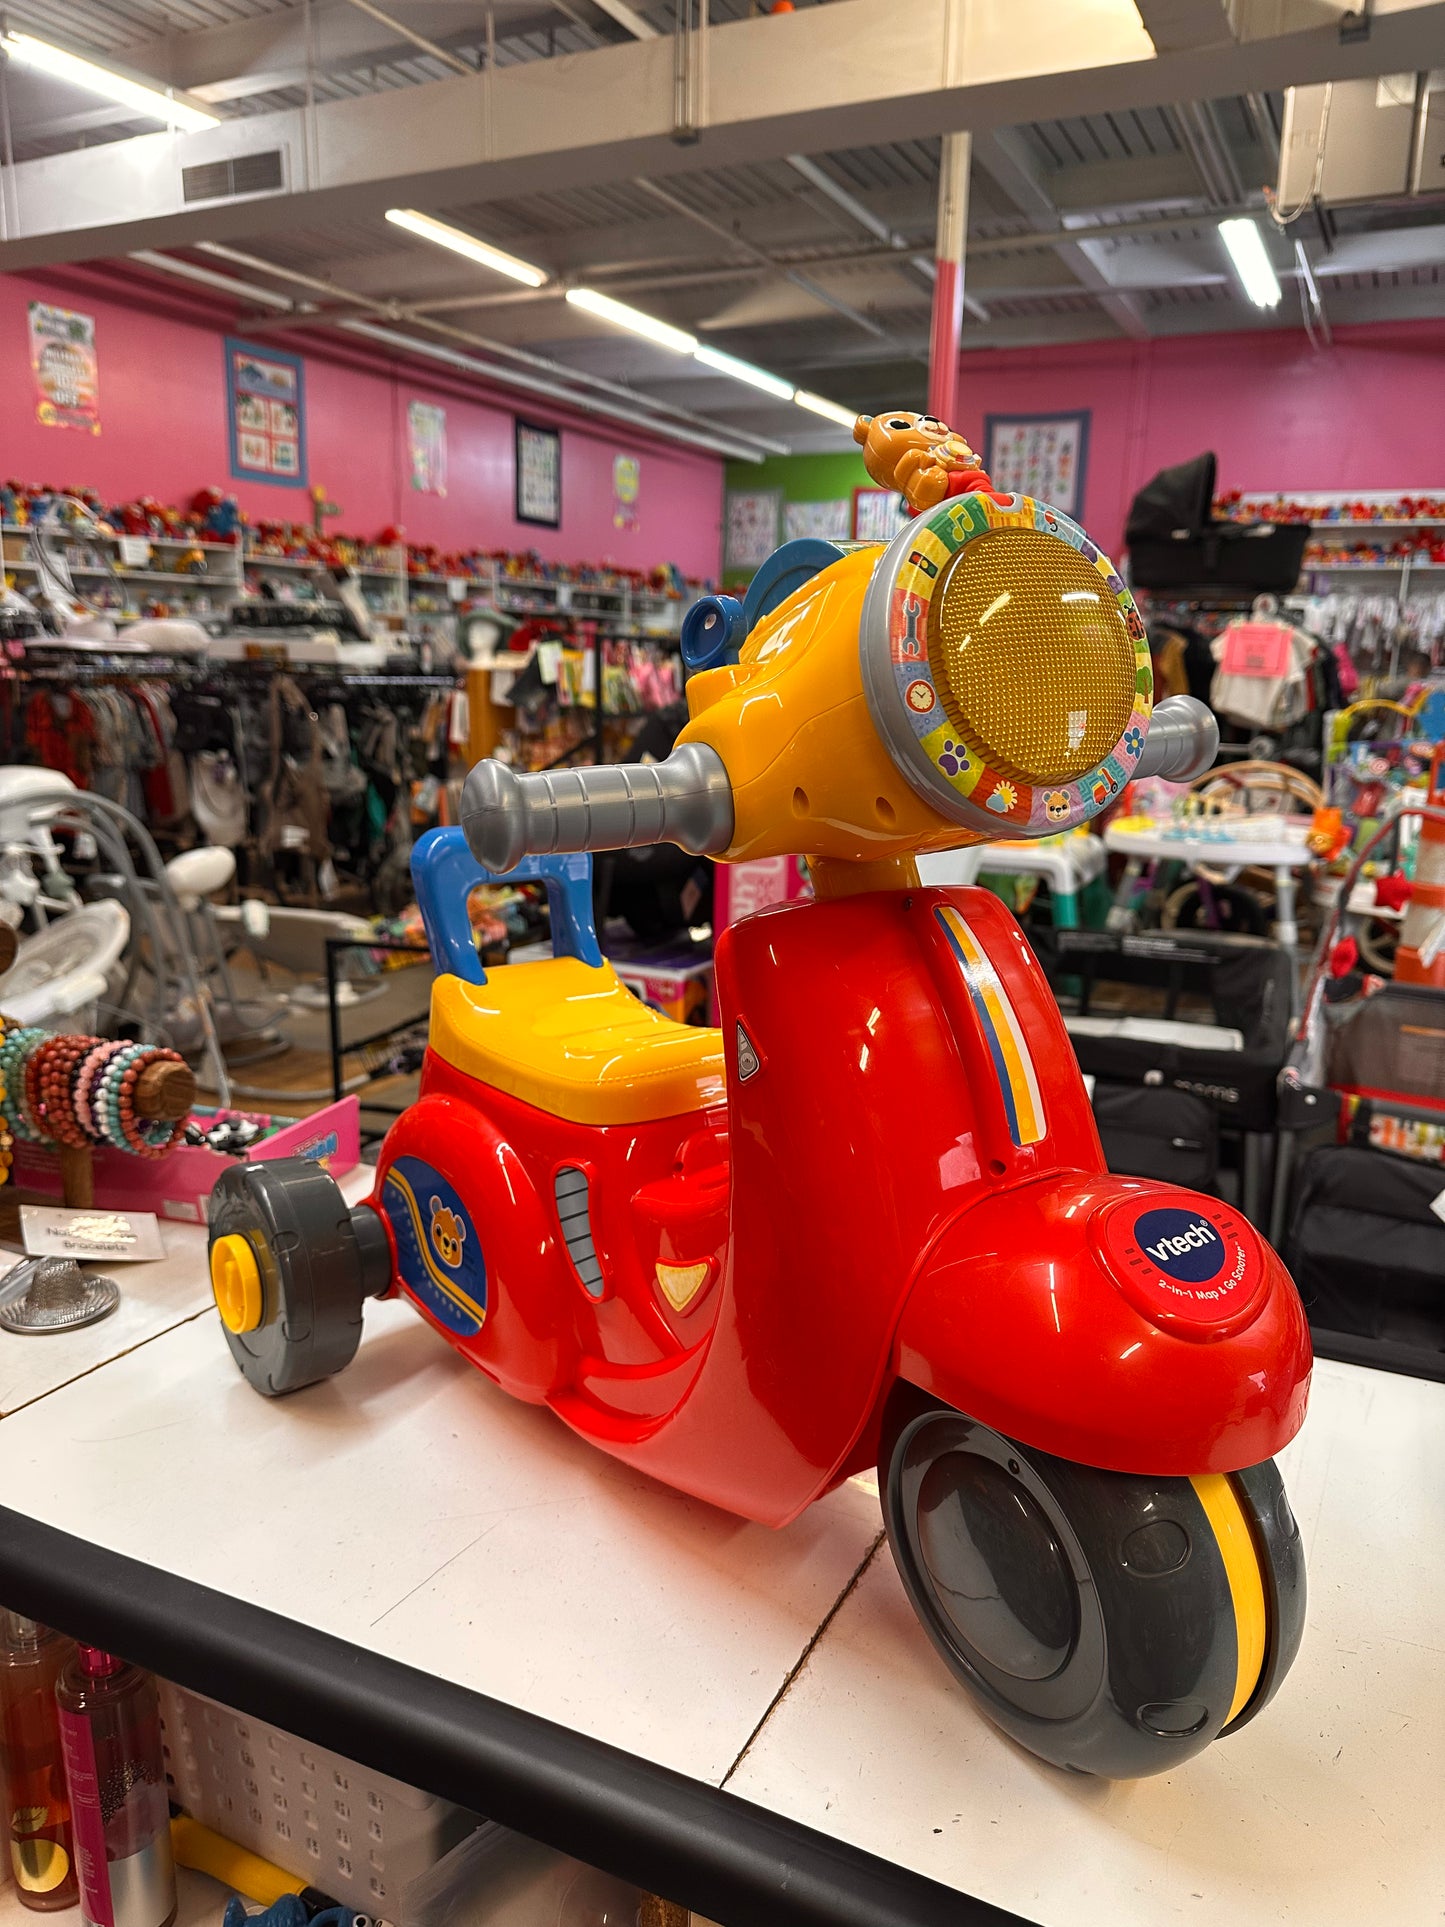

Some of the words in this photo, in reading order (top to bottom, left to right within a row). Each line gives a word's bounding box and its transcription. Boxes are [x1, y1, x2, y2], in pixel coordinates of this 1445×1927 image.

[1145, 1222, 1217, 1261] vtech
[1158, 1279, 1194, 1299] 2-in-1
[1195, 1290, 1219, 1301] Map
[1217, 1286, 1228, 1295] &
[1223, 1279, 1237, 1290] Go
[1231, 1245, 1247, 1281] Scooter
